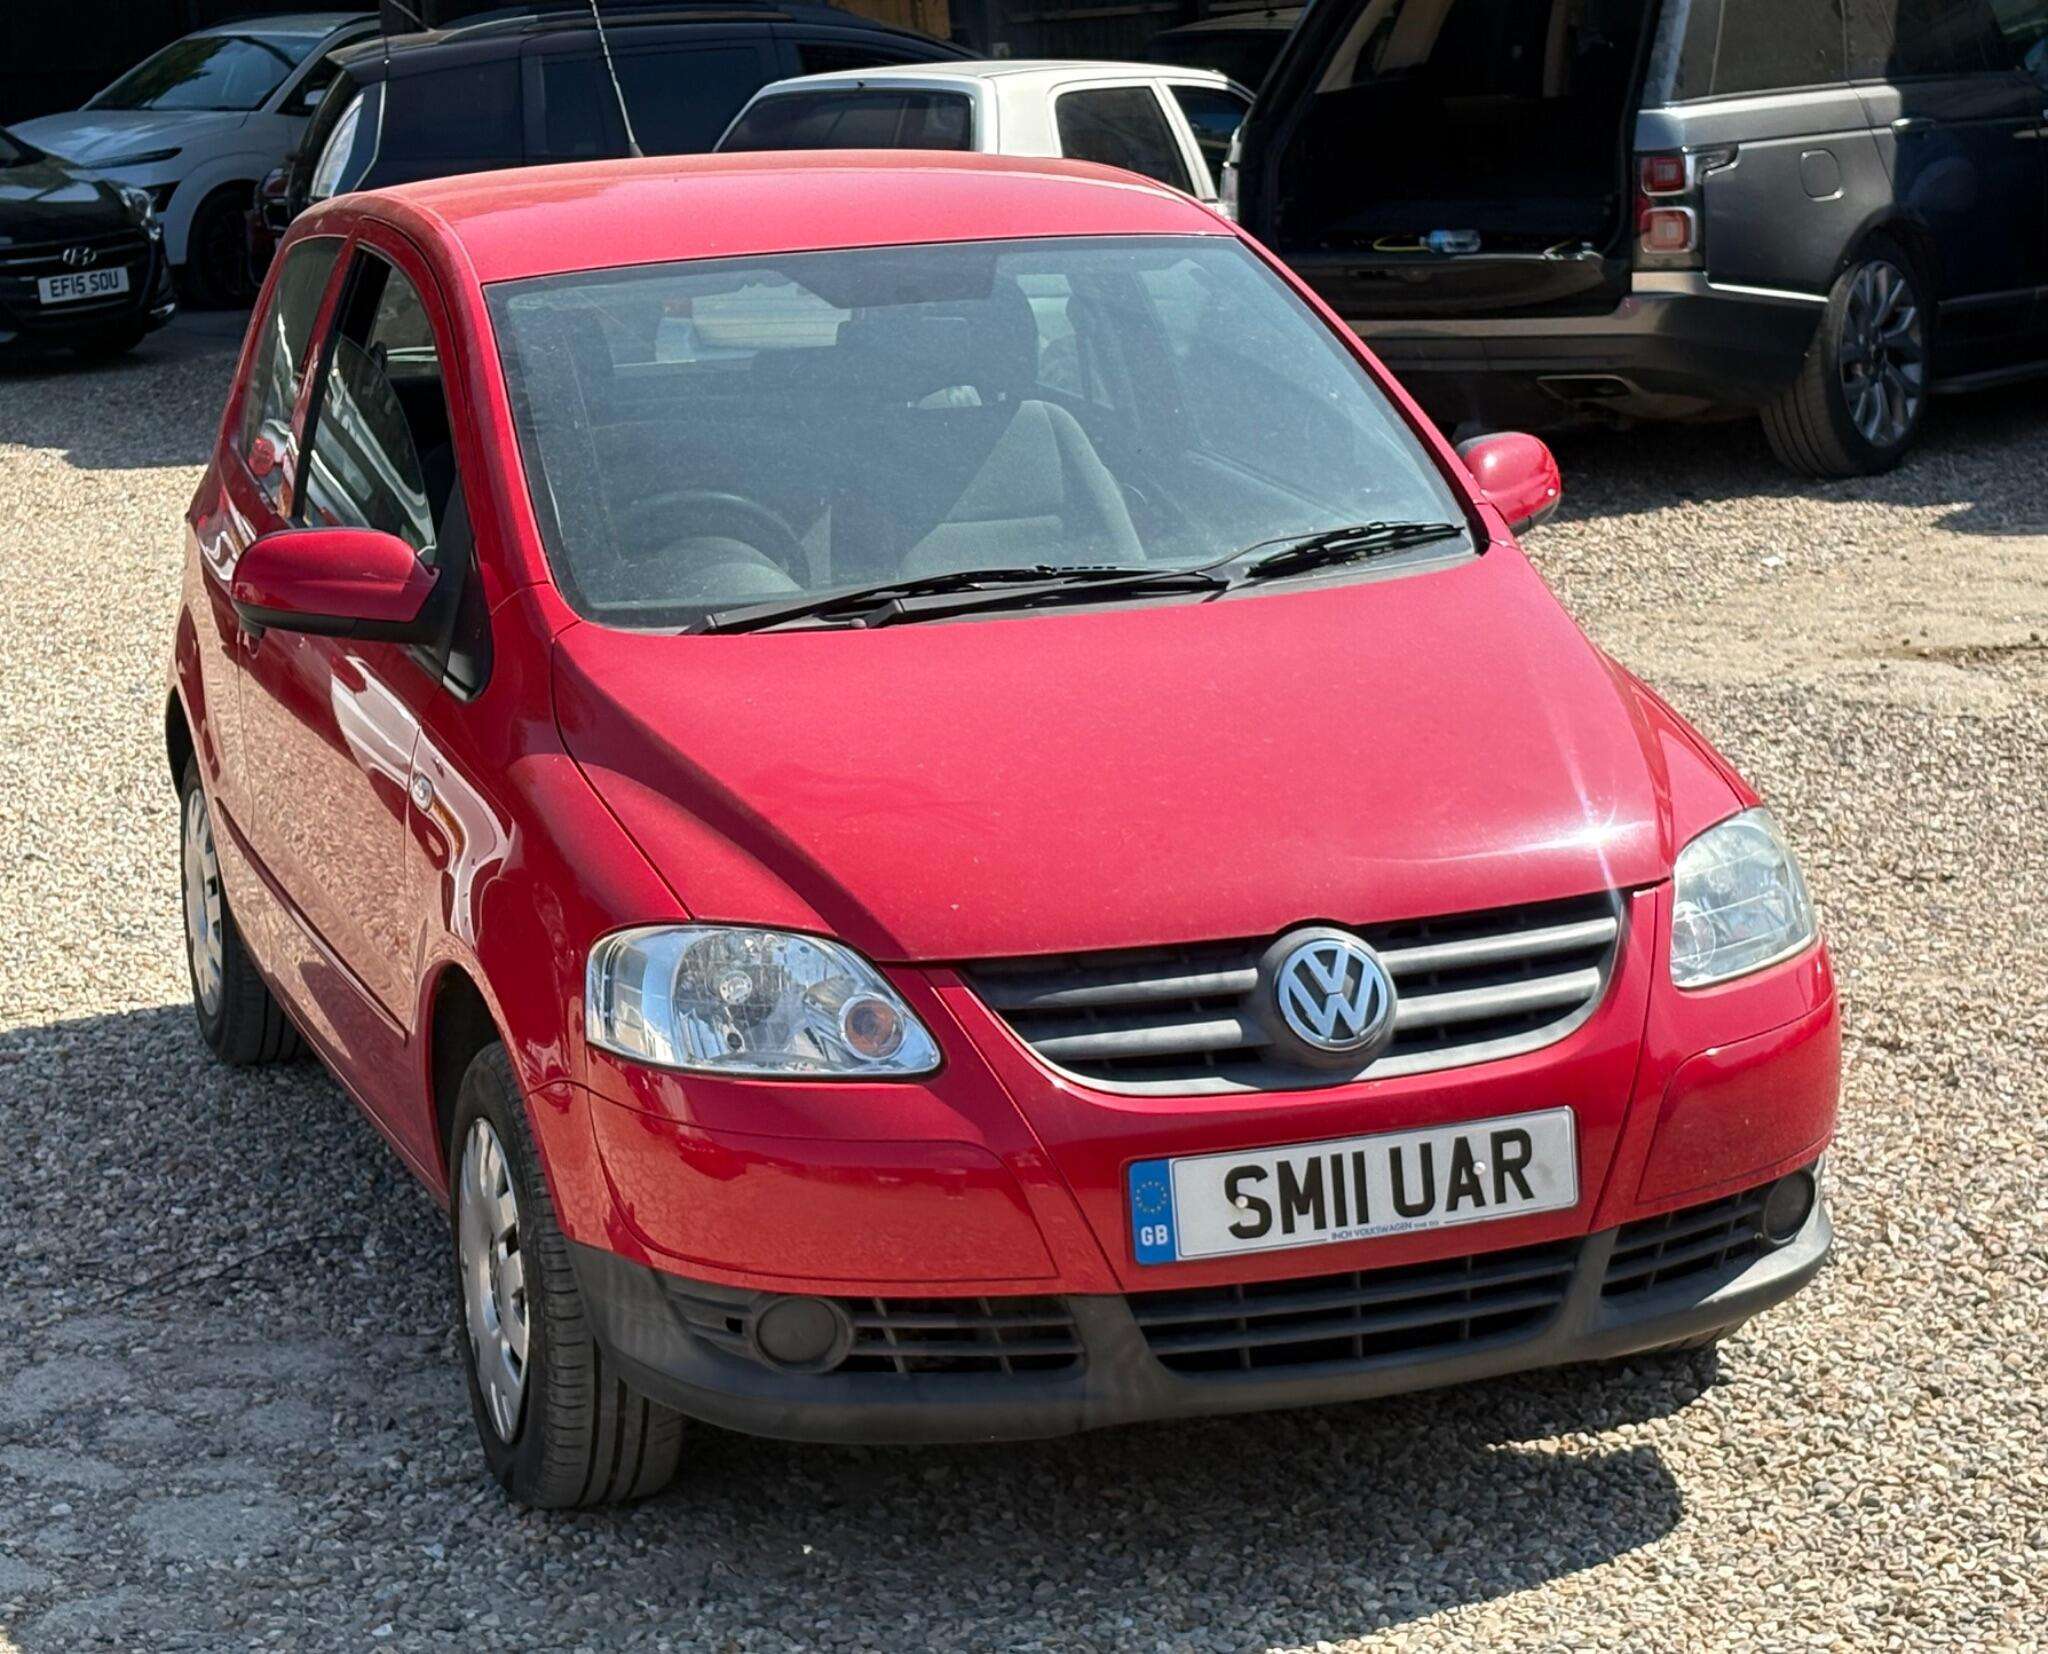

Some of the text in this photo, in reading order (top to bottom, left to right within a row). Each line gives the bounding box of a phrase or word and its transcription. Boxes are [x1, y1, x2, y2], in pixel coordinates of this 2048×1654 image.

[50, 271, 119, 298] EF15 SOU
[1224, 1128, 1535, 1240] SM11 UAR
[1141, 1225, 1168, 1246] GB
